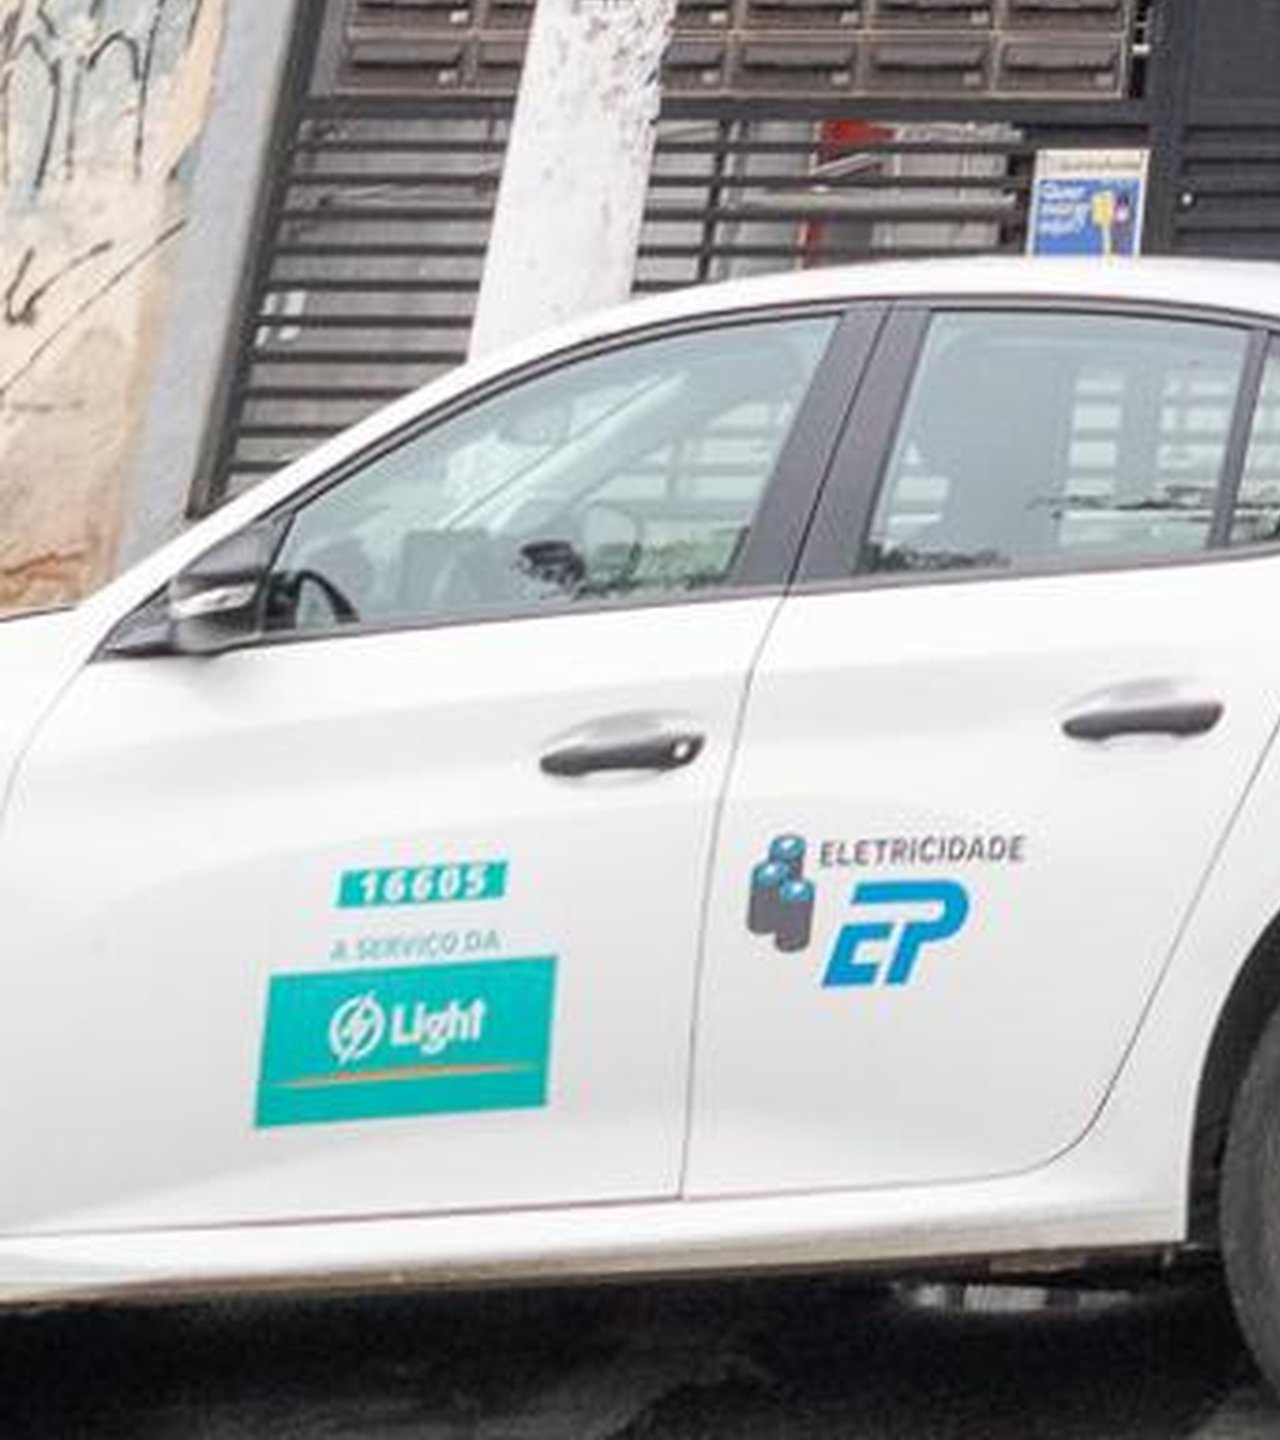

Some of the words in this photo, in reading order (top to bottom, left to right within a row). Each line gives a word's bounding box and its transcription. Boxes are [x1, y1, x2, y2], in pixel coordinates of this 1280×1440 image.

[820, 835, 1025, 867] ELETRICIDADE
[359, 864, 487, 903] 16605
[822, 879, 969, 987] EP
[390, 996, 486, 1054] Light
